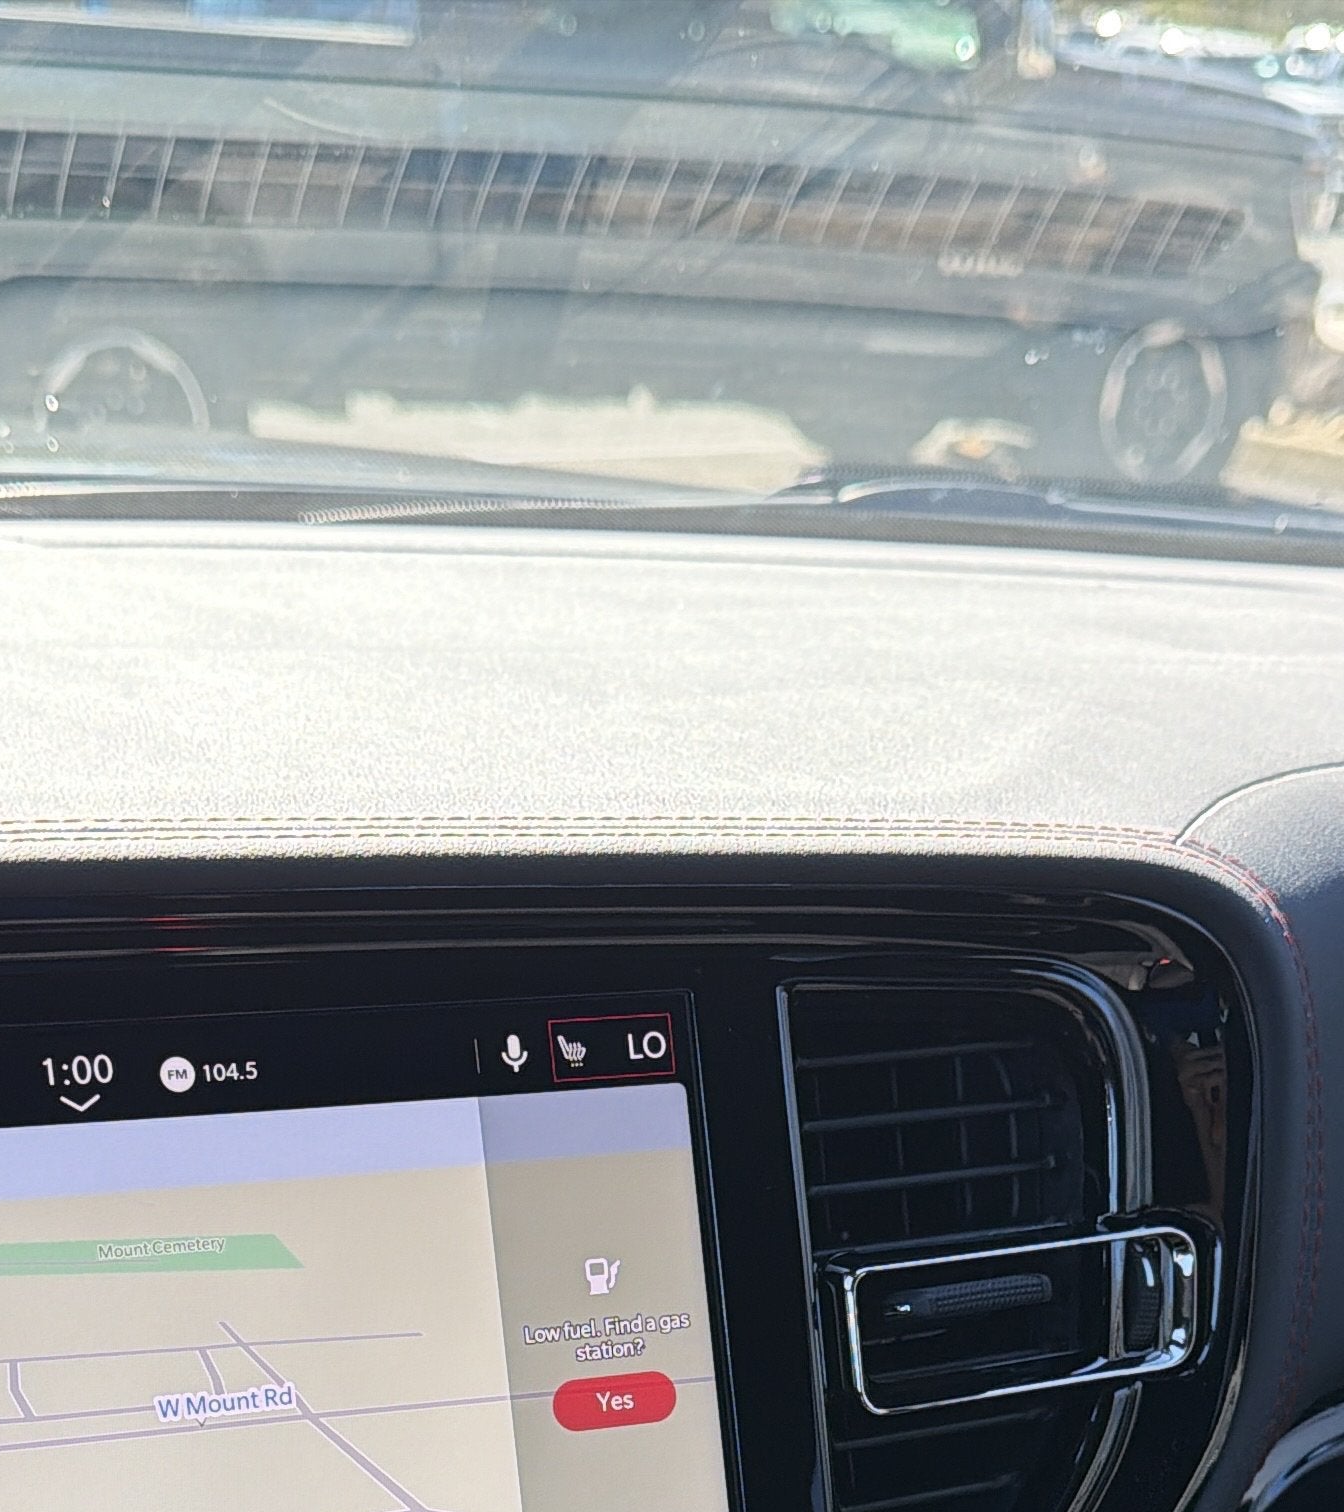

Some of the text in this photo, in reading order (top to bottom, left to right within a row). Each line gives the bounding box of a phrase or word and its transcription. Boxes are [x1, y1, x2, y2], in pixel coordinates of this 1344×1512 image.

[627, 1031, 666, 1060] LO
[42, 1055, 113, 1087] 1:00
[202, 1061, 258, 1082] 104.5
[98, 1236, 225, 1260] Mount Cemetery
[523, 1312, 691, 1346] Low fuel. Find a gas
[575, 1339, 645, 1362] station?
[159, 1386, 293, 1419] W Mount Rd
[596, 1392, 635, 1412] Yes
